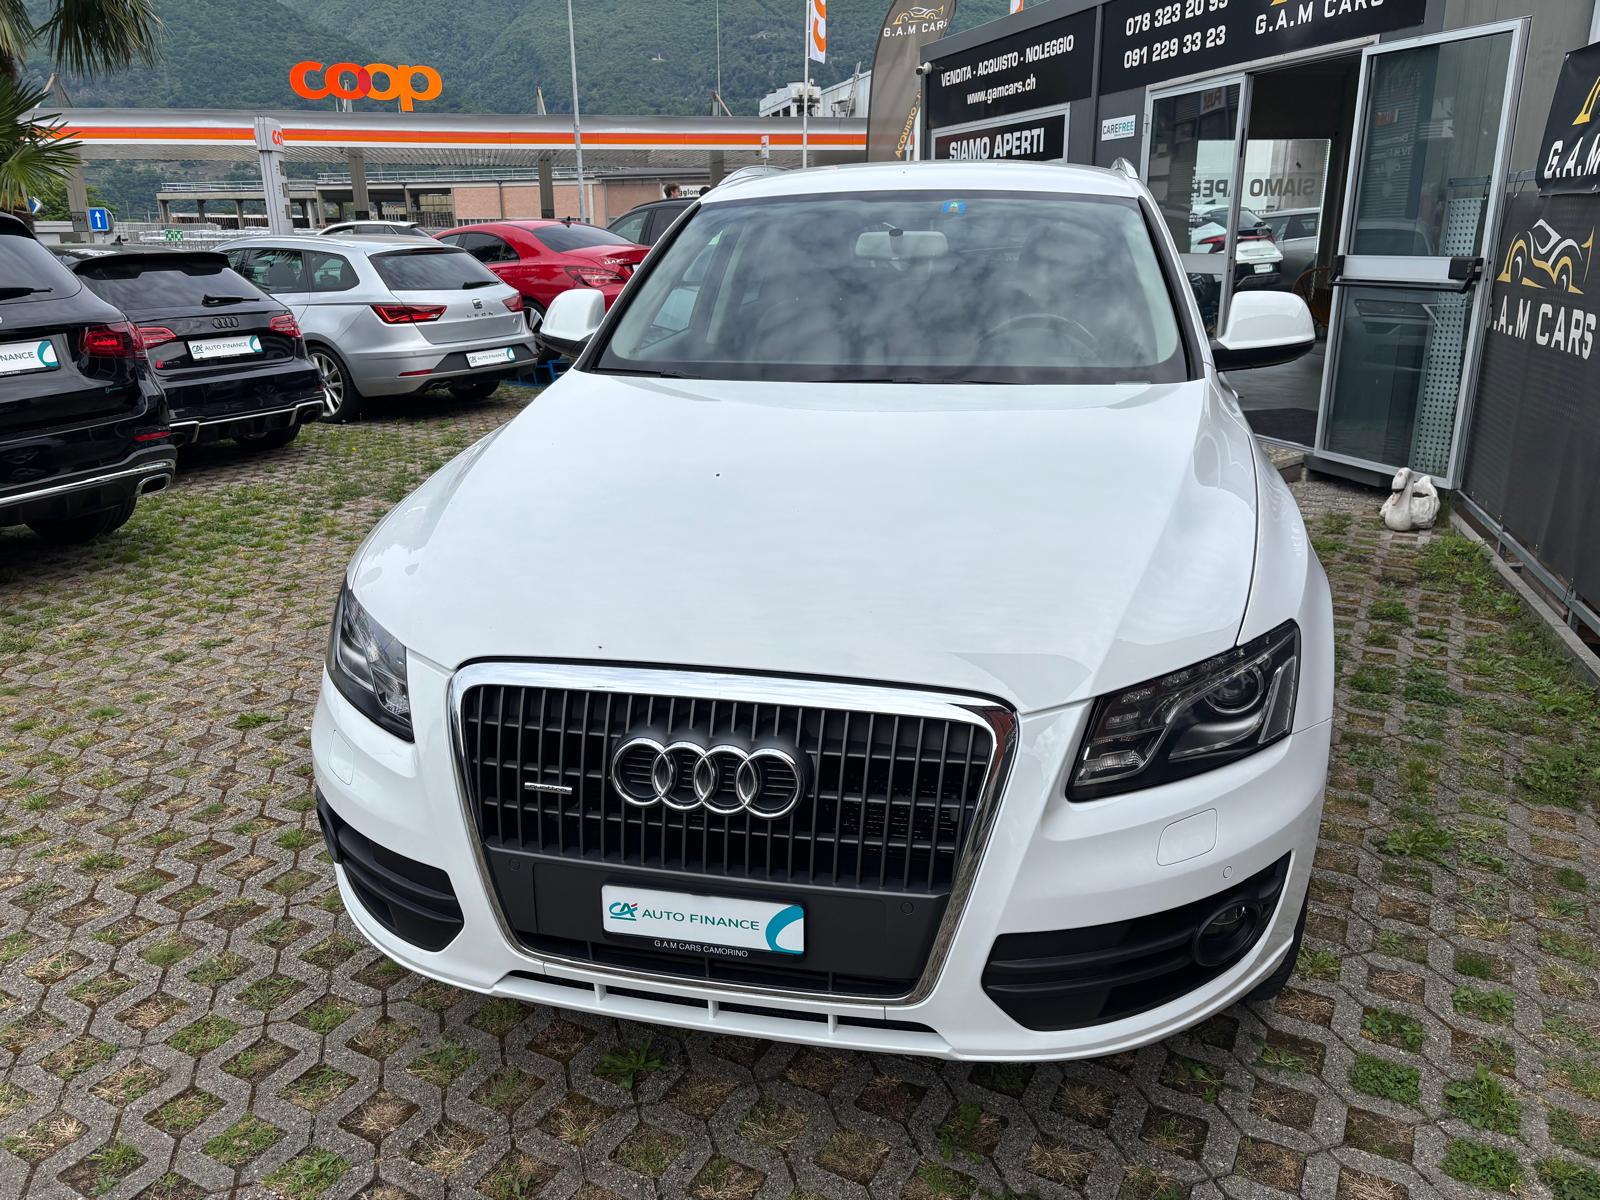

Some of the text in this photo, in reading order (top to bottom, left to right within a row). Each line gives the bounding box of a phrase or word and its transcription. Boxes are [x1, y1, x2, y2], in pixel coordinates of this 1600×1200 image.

[883, 24, 916, 37] G.A.M
[1125, 12, 1151, 36] 078
[1154, 2, 1181, 28] 323
[1185, 0, 1204, 19] 20
[1255, 1, 1314, 35] G.A.M
[941, 66, 972, 87] VENDITA
[977, 51, 1019, 77] ACQUISTO
[1025, 34, 1074, 64] NOLEGGIO
[1123, 24, 1226, 69] 091 229 33 23
[289, 60, 443, 112] coop
[966, 73, 1037, 105] www.gamcars.ch
[895, 106, 917, 158] ACQUISTO
[949, 127, 1045, 161] SIAMO APERTI
[1102, 121, 1134, 135] CAREFREE
[1535, 303, 1597, 360] CARS
[642, 908, 685, 922] AUTO
[689, 914, 760, 931] FINANCE
[654, 940, 748, 958] G.A.M CARS CAMORINO
